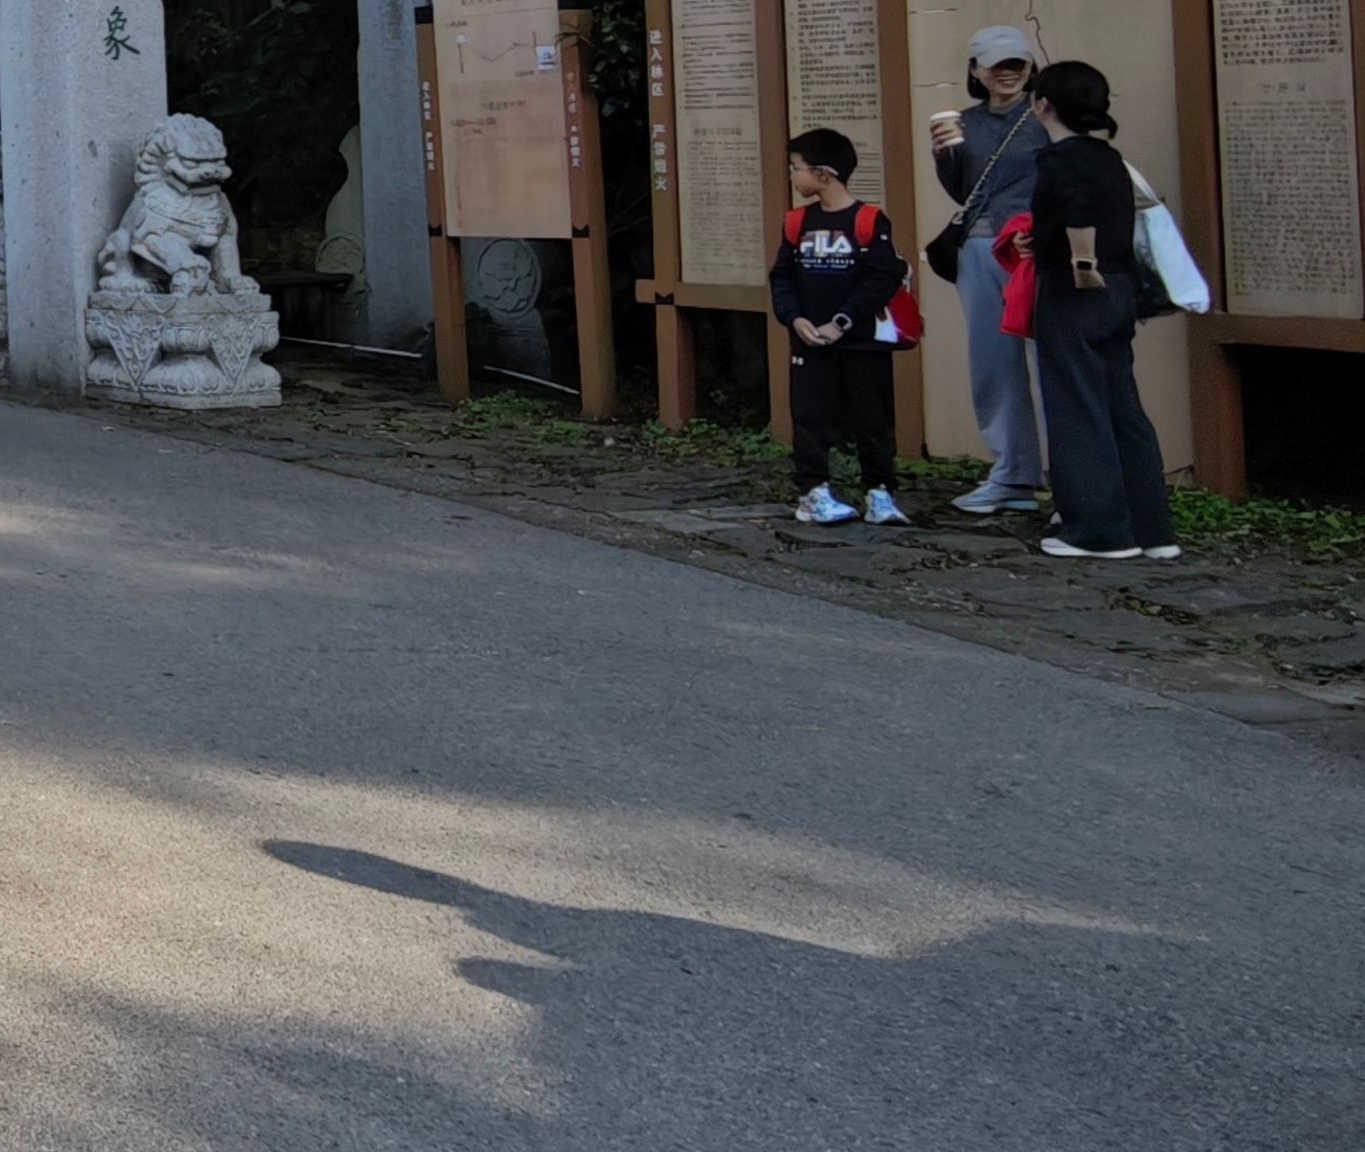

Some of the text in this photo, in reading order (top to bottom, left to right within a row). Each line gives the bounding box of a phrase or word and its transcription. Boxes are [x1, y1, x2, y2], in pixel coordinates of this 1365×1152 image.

[649, 29, 665, 97] 进入林区
[799, 235, 853, 254] FILA
